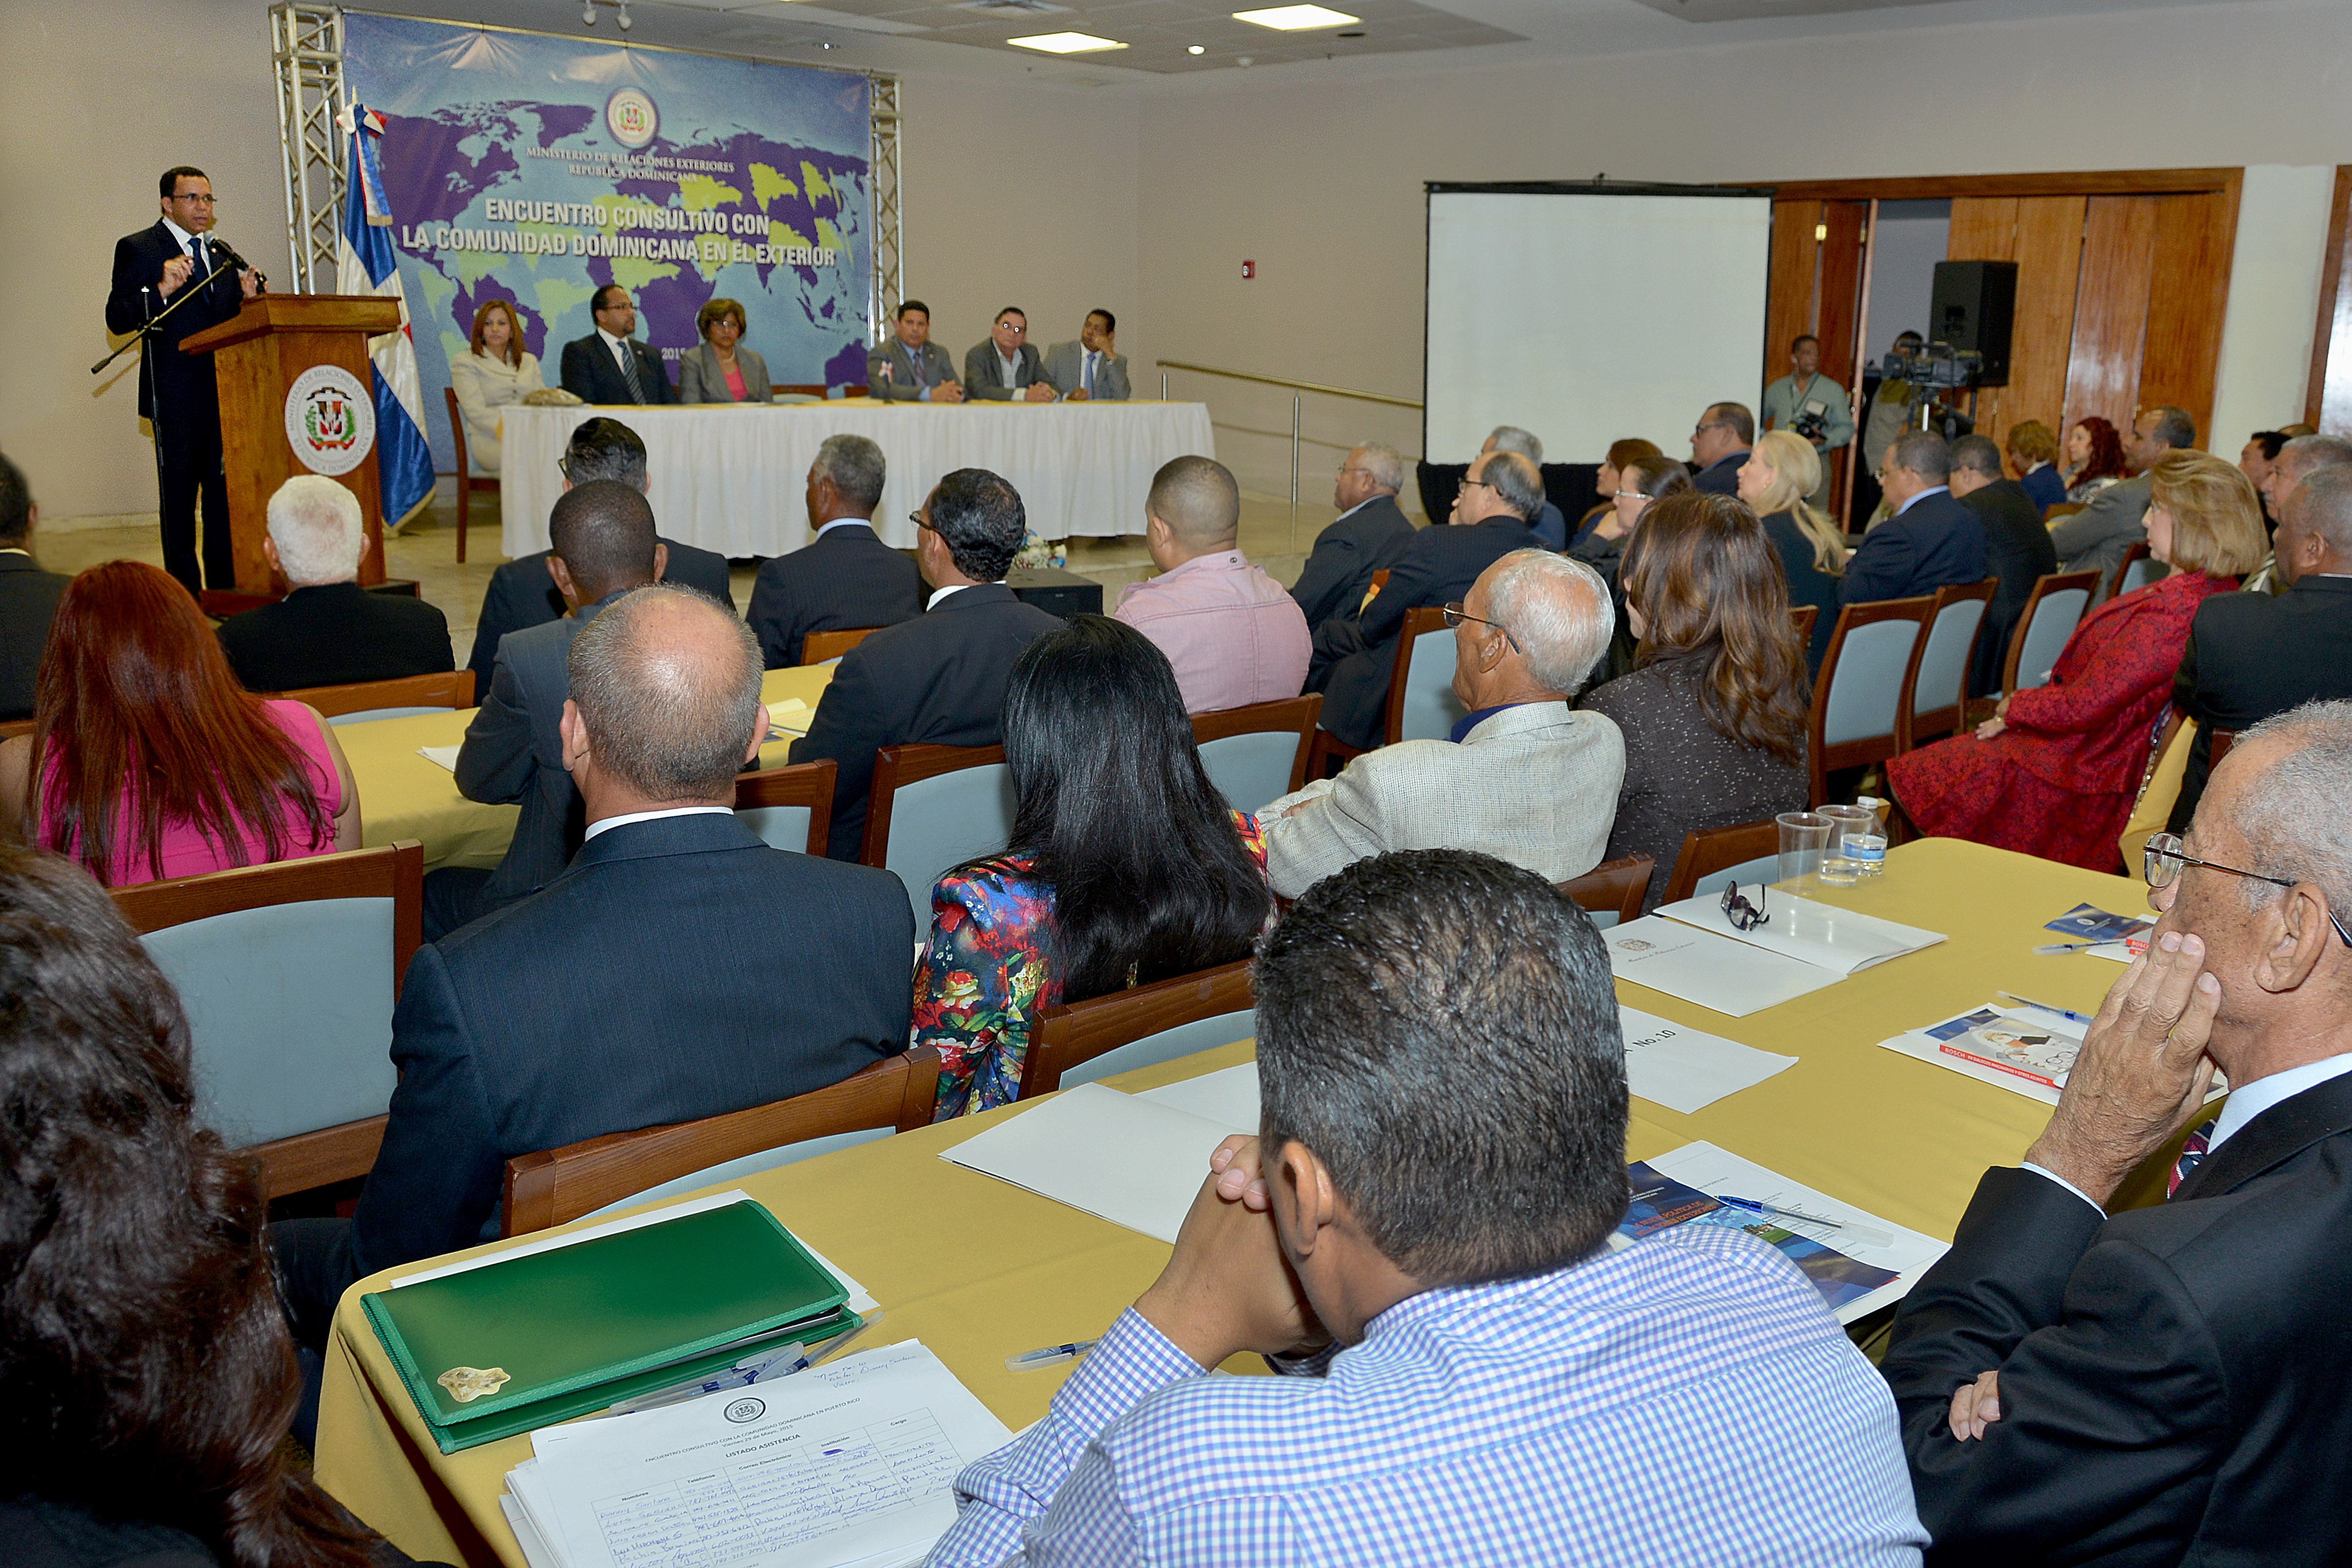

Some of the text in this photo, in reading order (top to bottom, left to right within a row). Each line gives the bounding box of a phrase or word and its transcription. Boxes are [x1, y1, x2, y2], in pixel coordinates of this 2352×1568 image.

[527, 147, 735, 173] MINISTERIO DE RELACIONES EXTERIORES
[628, 168, 698, 183] DOMINICANA
[485, 198, 769, 236] ENCUENTRO CONSULTIVO CON
[402, 224, 835, 267] LA COMUNIDAD DOMINICANA EN EL EXTERIOR
[1944, 1047, 1965, 1059] BOSCH
[645, 1449, 681, 1464] ENCUENTRO
[682, 1440, 719, 1455] CONSULTIVO
[719, 1436, 733, 1445] CON
[733, 1433, 741, 1441] LA
[741, 1422, 778, 1438] COMUNIDAD
[778, 1411, 815, 1427] DOMINICANA
[824, 1401, 847, 1414] PUERTO
[846, 1397, 861, 1407] RICO
[890, 1418, 907, 1426] Cargo
[722, 1439, 744, 1448] Viernes
[761, 1428, 778, 1438] Mayo,
[779, 1424, 794, 1433] 2015
[725, 1433, 801, 1458] LISTADO ASISTENCIA
[821, 1436, 850, 1447] Institución
[738, 1453, 792, 1470] Correo Electrónico
[621, 1491, 649, 1501] Nombres
